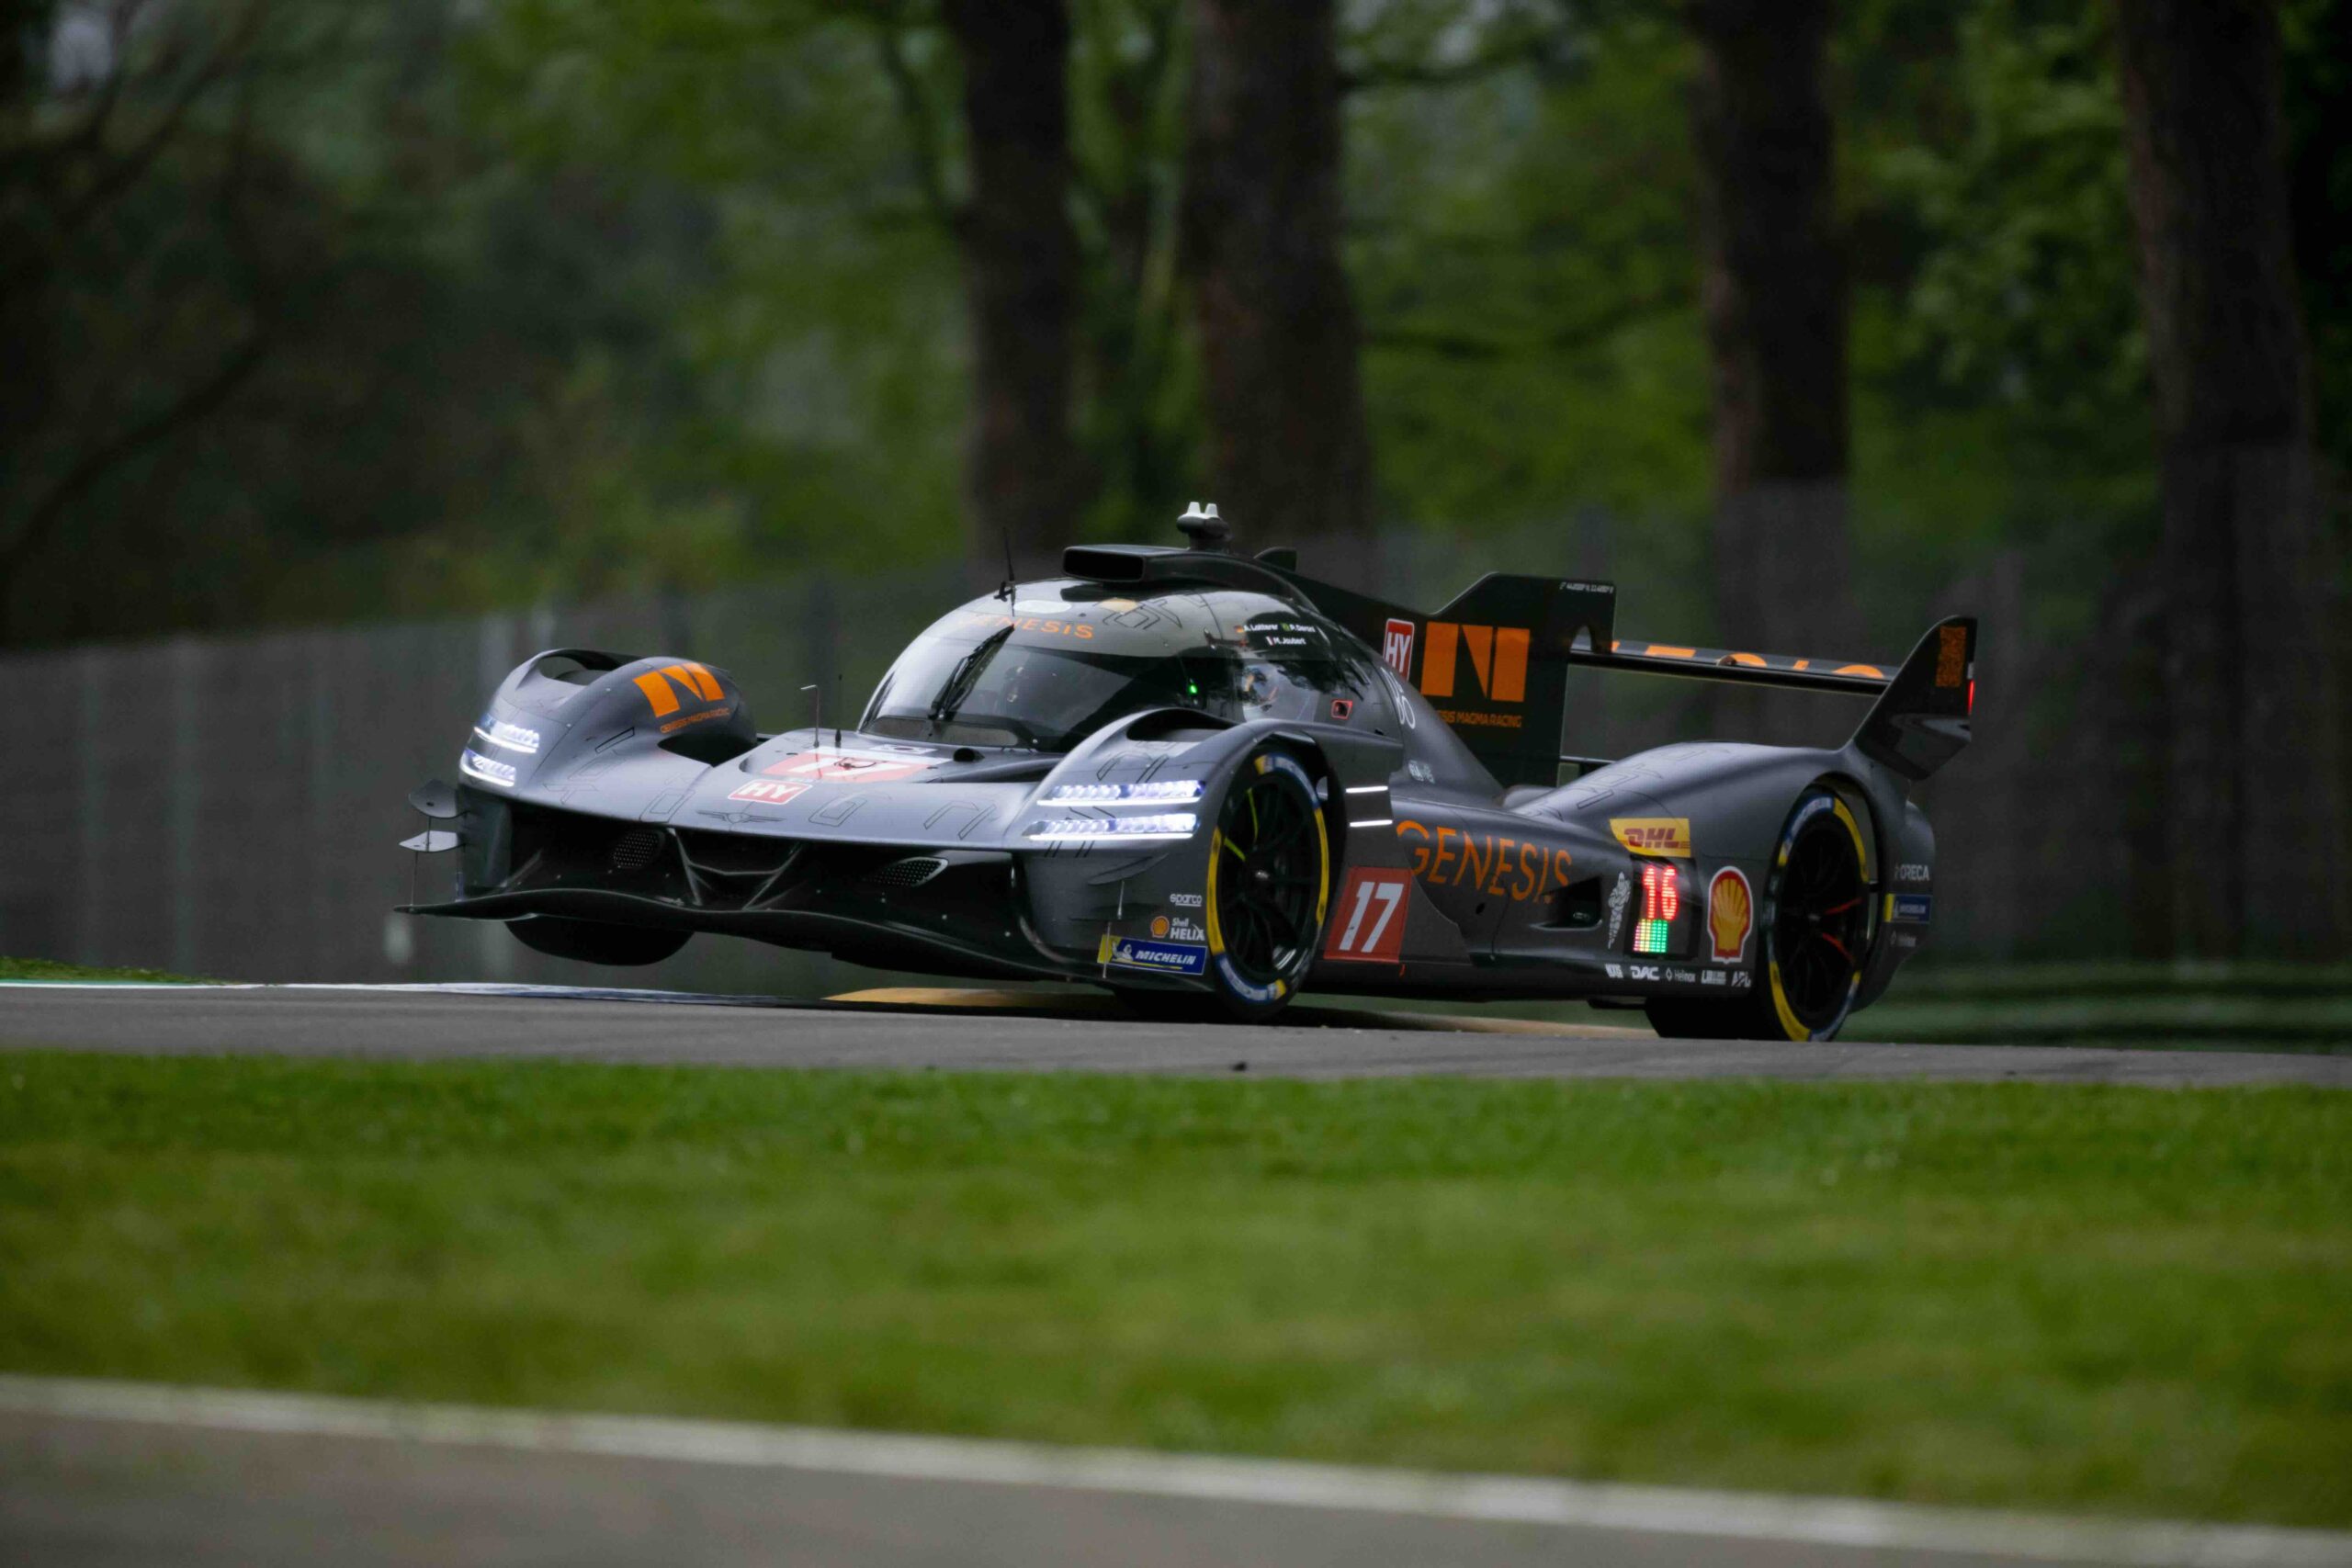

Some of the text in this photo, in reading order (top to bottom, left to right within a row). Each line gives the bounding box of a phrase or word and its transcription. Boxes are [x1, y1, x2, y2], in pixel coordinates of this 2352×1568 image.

[958, 614, 1095, 640] NESIS
[1385, 631, 1411, 673] HY
[739, 782, 797, 799] HY
[1624, 828, 1680, 849] DHL
[1396, 819, 1573, 905] GENESIS
[1170, 893, 1203, 907] sparco
[1643, 863, 1679, 920] 16
[1172, 917, 1189, 927] Shell
[1339, 881, 1404, 953] 17
[1170, 926, 1205, 942] HELIX
[1136, 951, 1196, 965] MICHELIN
[1630, 966, 1660, 981] DAC
